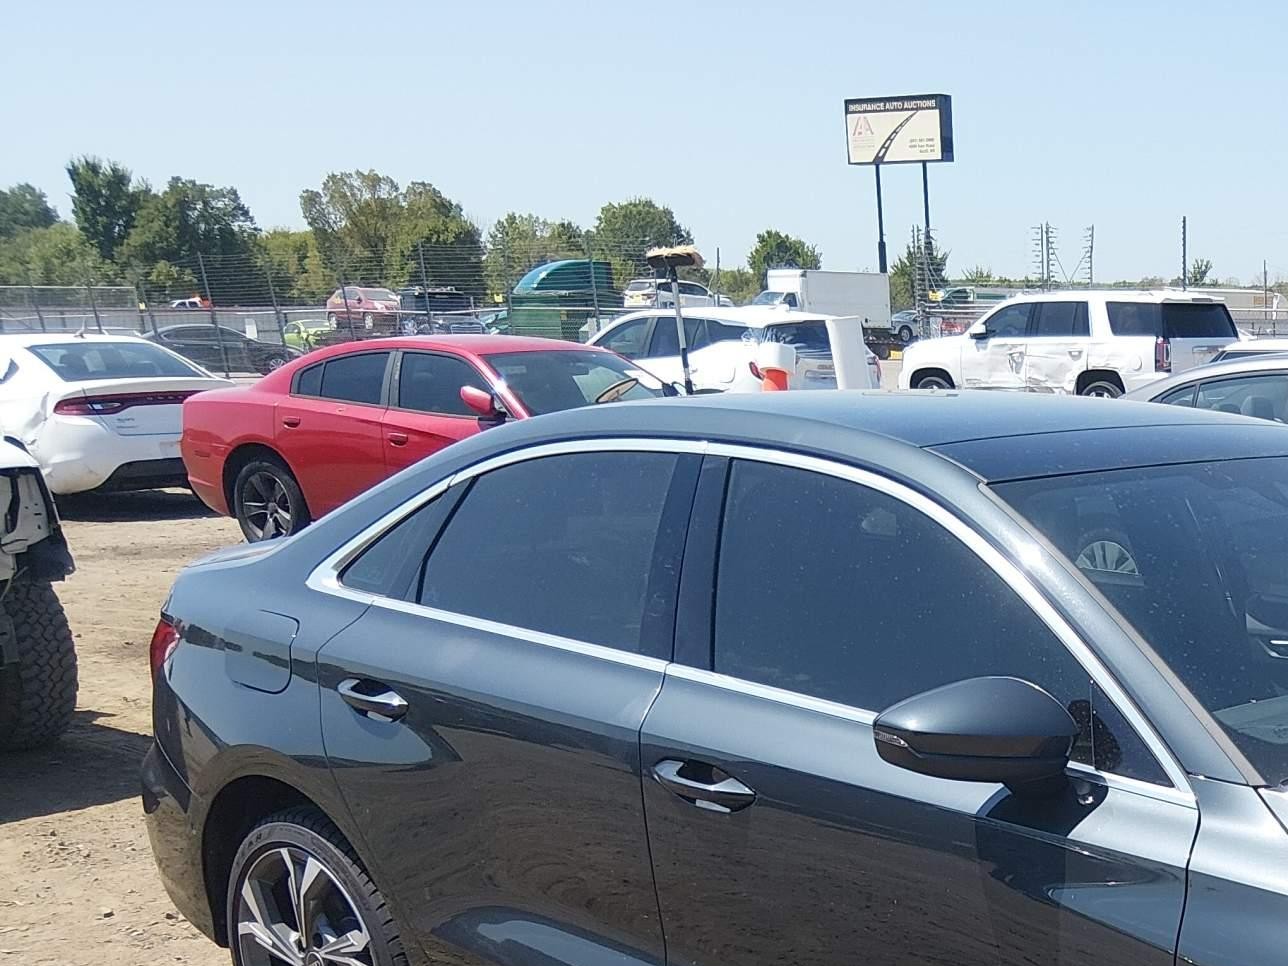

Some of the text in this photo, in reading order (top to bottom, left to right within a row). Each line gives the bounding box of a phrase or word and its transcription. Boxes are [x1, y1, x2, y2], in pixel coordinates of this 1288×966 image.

[848, 99, 936, 112] INSURANCE AUTO AUCTIONS
